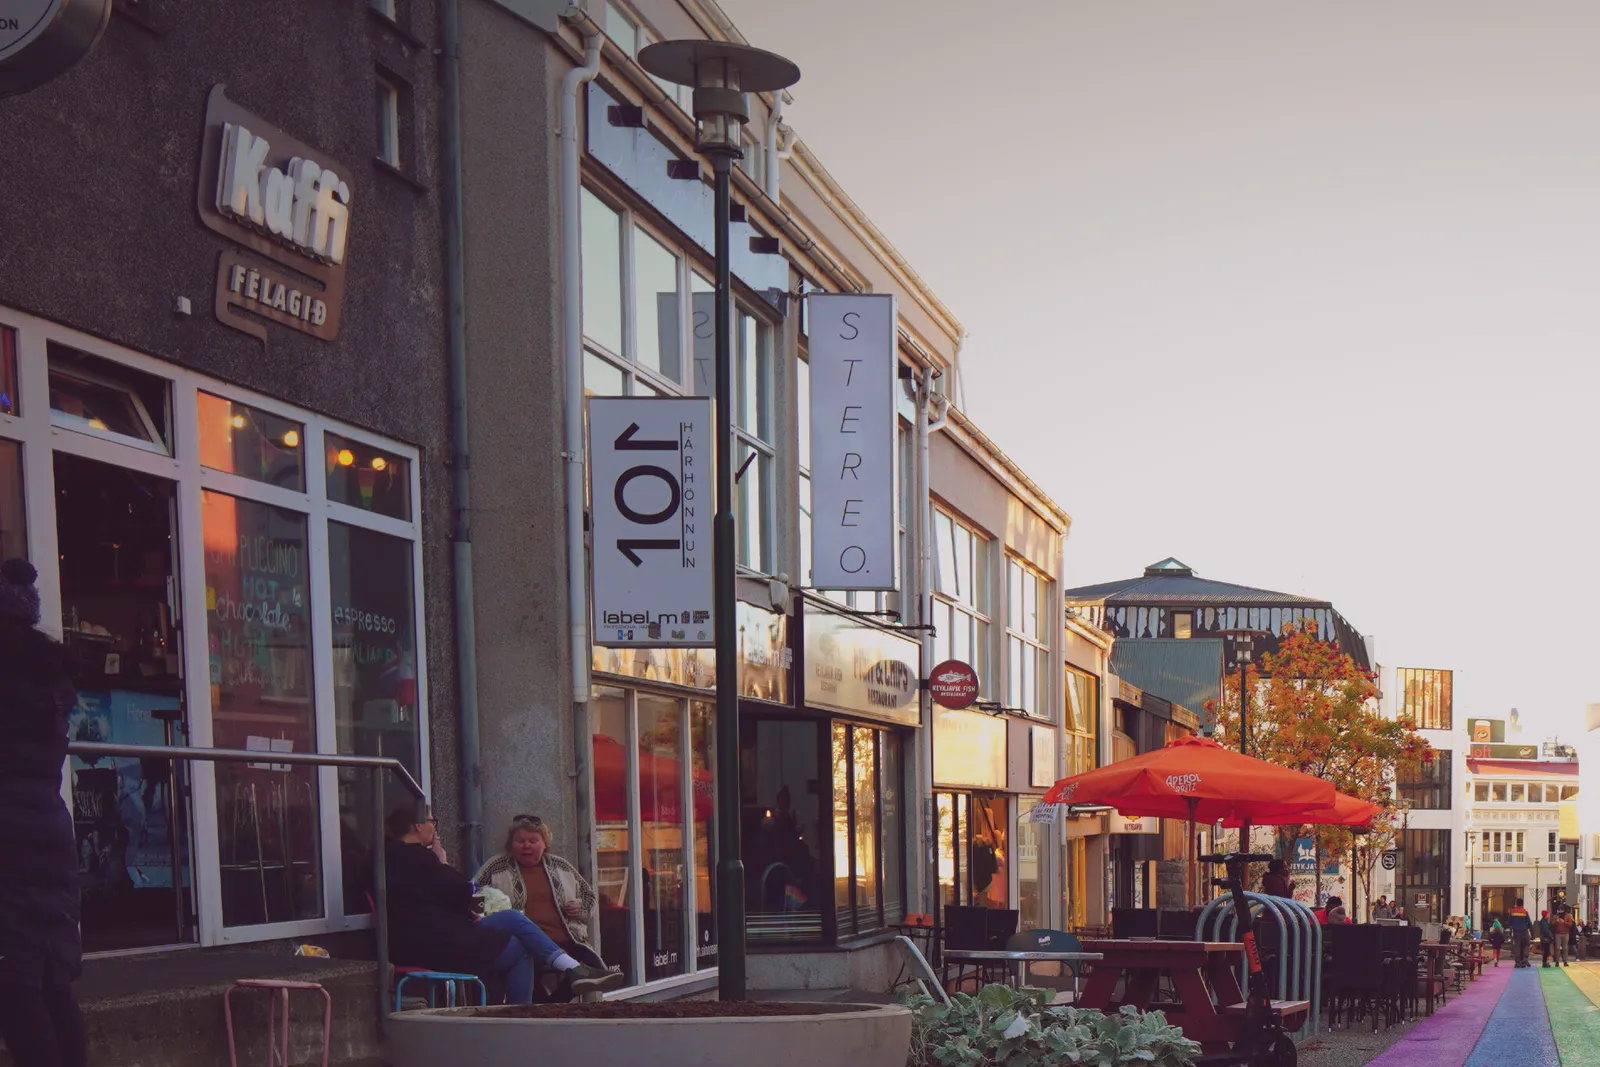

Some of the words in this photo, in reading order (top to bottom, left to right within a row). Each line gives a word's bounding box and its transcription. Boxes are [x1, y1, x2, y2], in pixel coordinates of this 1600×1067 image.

[217, 121, 350, 266] Kaffi
[230, 263, 327, 326] FÉLAGIÐ
[614, 422, 681, 567] 101
[603, 610, 678, 624] labelm
[1470, 744, 1492, 758] loft
[1165, 773, 1202, 787] APEROL
